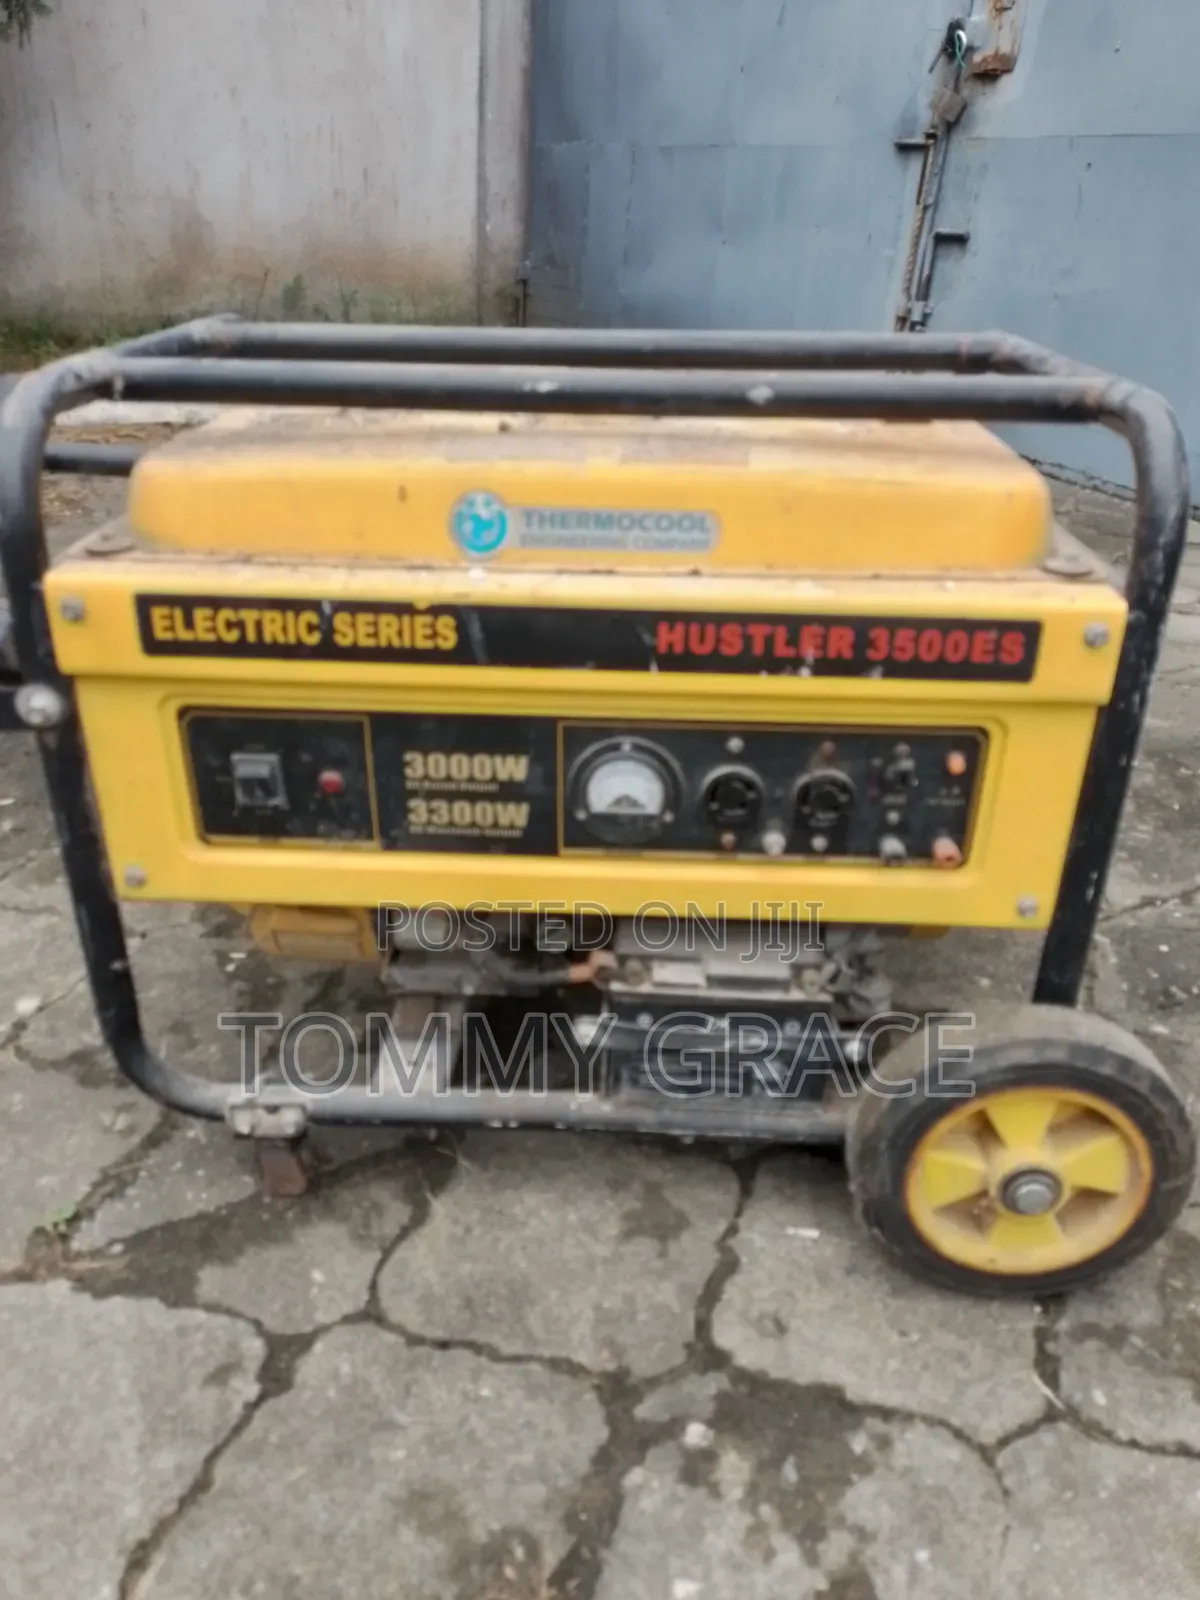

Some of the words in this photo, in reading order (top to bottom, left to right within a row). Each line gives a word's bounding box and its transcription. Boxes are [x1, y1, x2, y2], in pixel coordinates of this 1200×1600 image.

[522, 508, 712, 533] THERMOCOOL
[150, 605, 321, 645] ELECTRIC
[332, 610, 457, 650] SERIES
[656, 621, 855, 660] HUSTLER
[866, 628, 1025, 664] 3500ES
[403, 750, 529, 782] 3000W
[407, 798, 530, 829] 3300W
